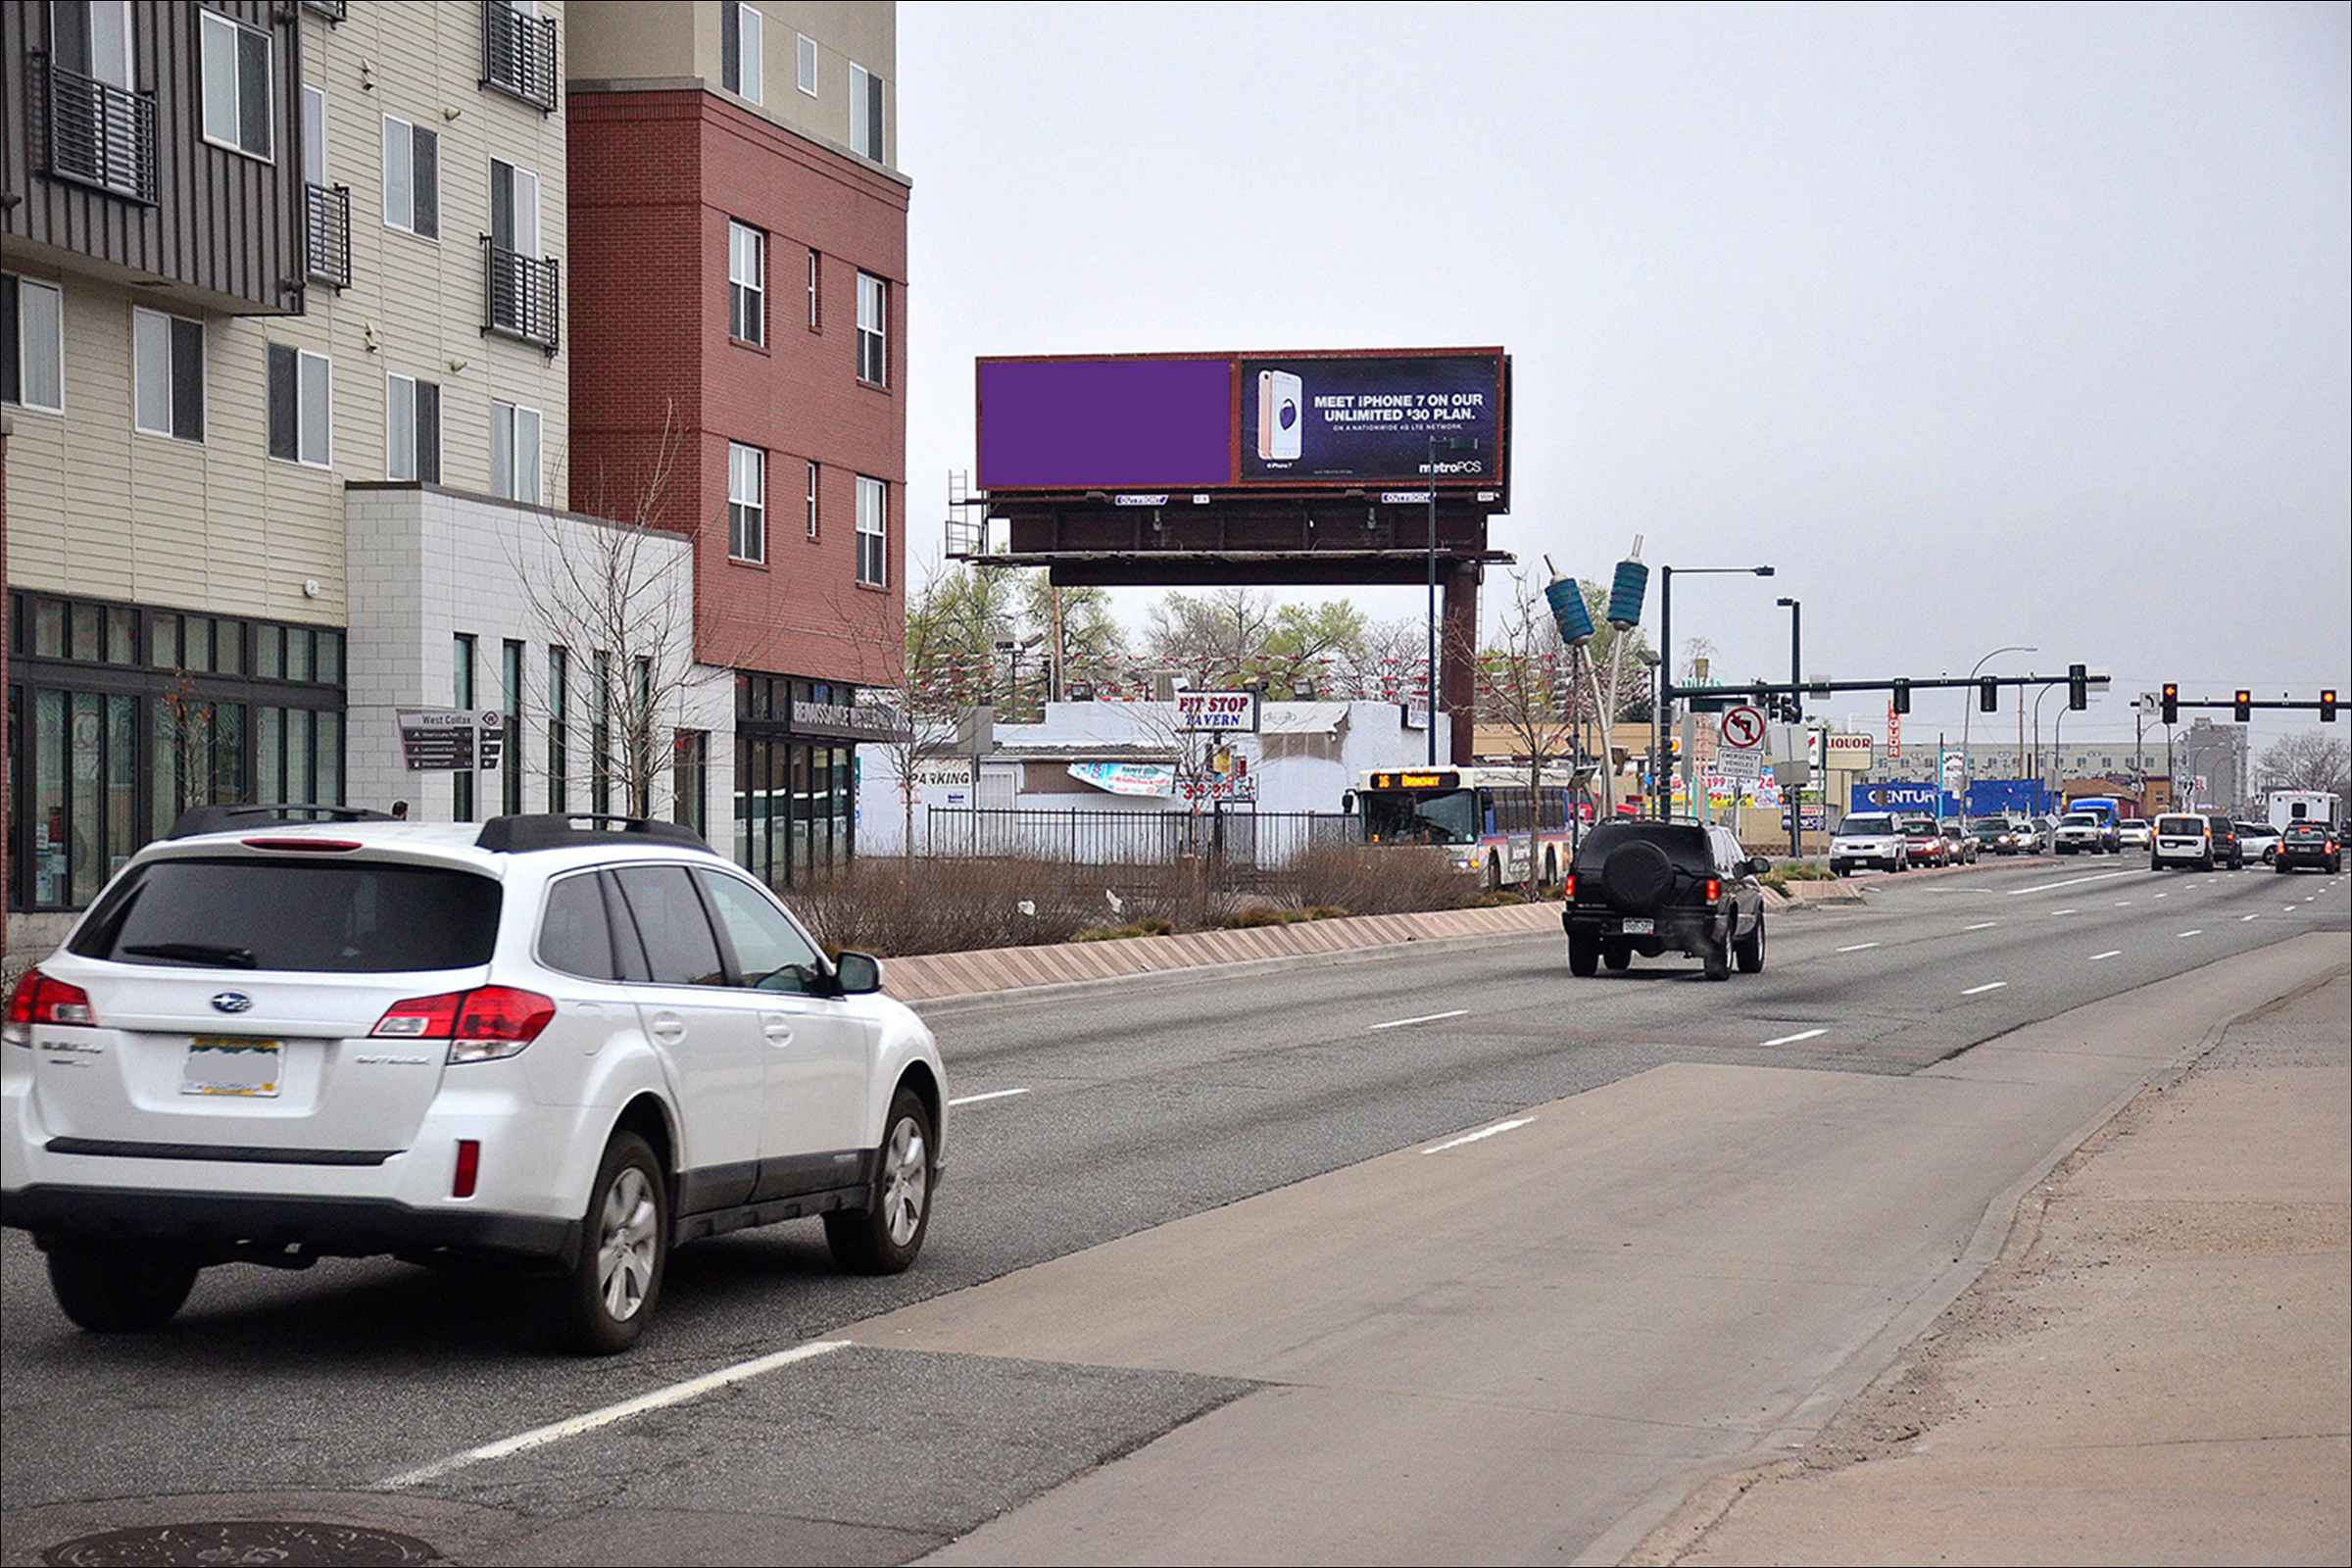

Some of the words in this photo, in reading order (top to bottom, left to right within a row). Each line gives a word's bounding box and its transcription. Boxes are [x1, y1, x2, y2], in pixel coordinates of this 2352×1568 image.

[1314, 395, 1354, 409] MEET
[1416, 395, 1425, 408] 7
[1427, 394, 1448, 408] ON
[1451, 394, 1484, 407] OUR
[1324, 409, 1403, 421] UNLIMITED
[1406, 409, 1430, 420] $30
[1433, 408, 1476, 420] PLAN.
[1179, 697, 1204, 712] PIT
[1208, 697, 1249, 712] STOP
[422, 715, 443, 724] West
[445, 714, 471, 724] Colfax
[1185, 714, 1241, 726] TAVERN
[1722, 753, 1758, 761] EMERGENCY
[911, 771, 969, 784] PARKING
[1379, 775, 1390, 788] 16
